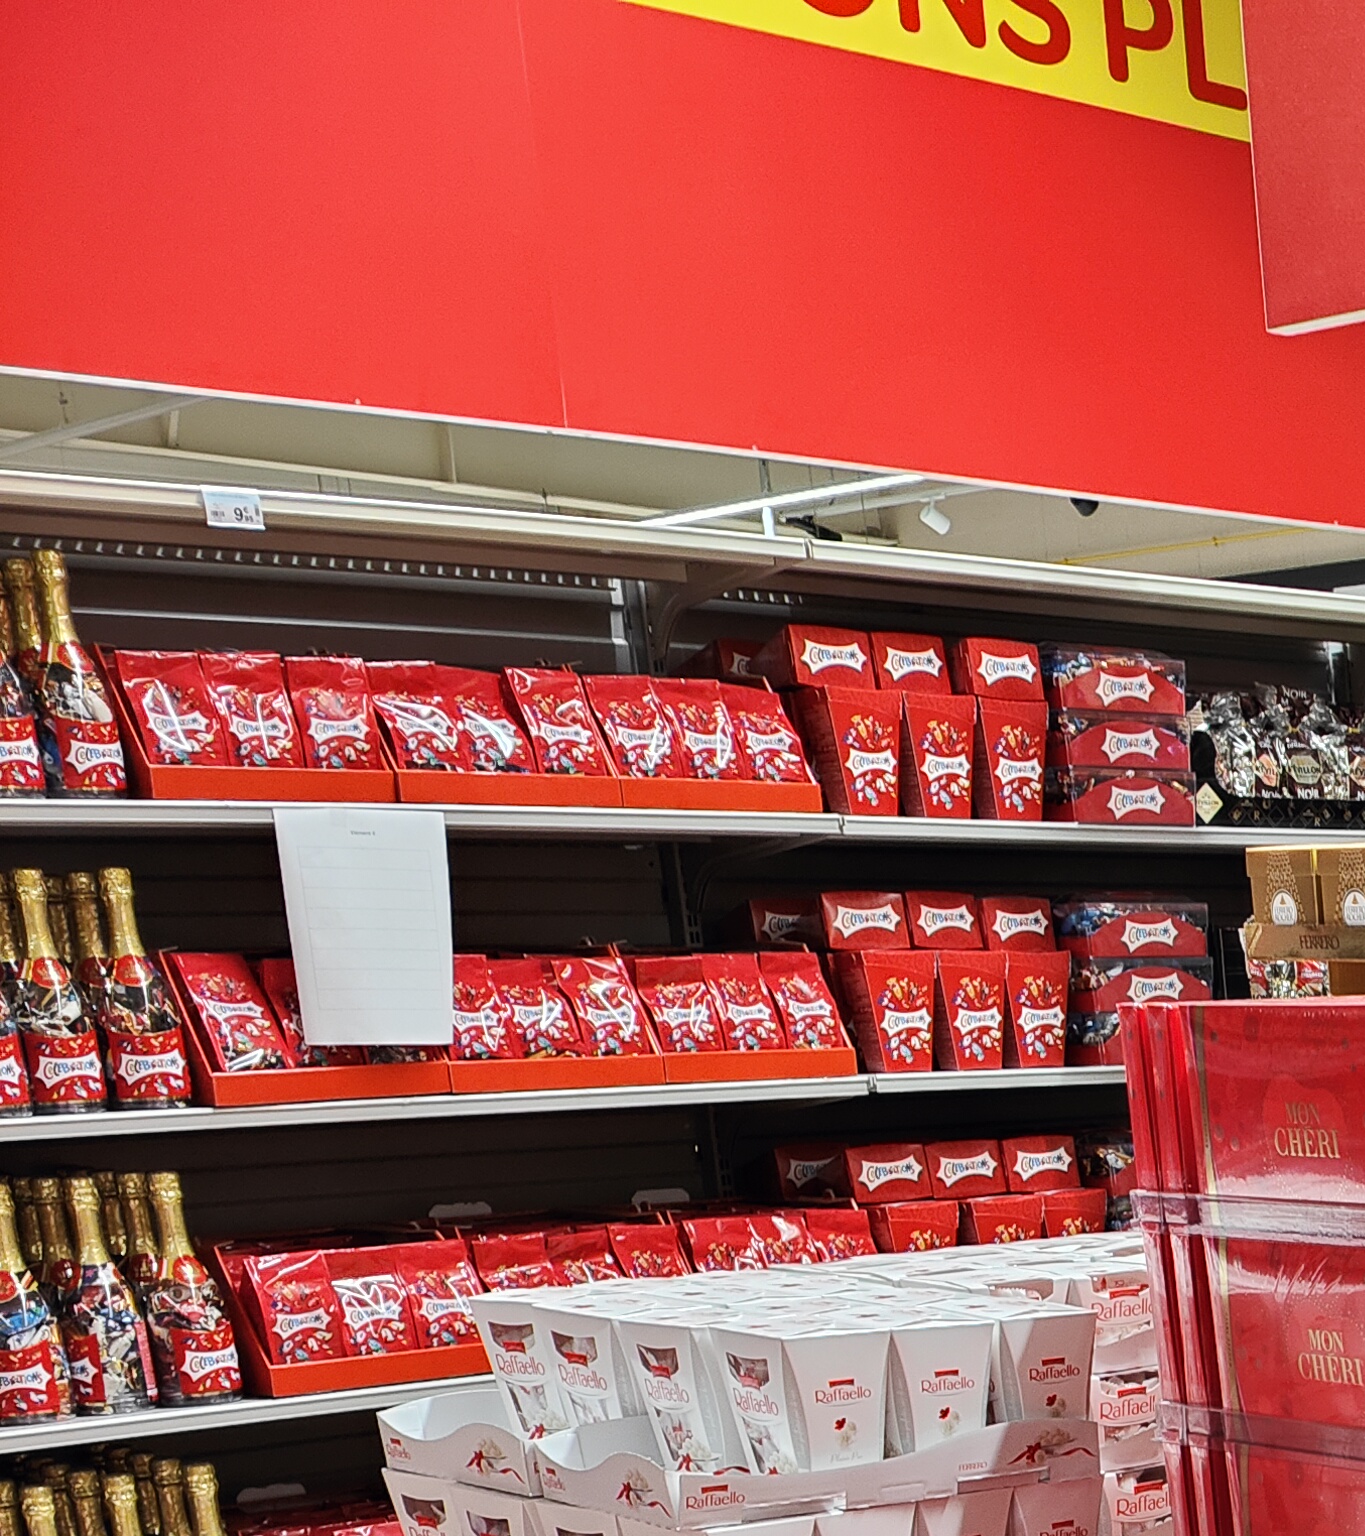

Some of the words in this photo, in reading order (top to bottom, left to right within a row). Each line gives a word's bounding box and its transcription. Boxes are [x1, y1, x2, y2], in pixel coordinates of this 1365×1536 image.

[798, 0, 1070, 65] NS
[808, 646, 860, 666] CELEBRATIONS
[890, 651, 938, 671] CELEBRATIONS
[985, 655, 1032, 675] CELEBRATIONS
[1102, 675, 1150, 698] CELEBRATIONS
[1109, 733, 1156, 755] CELEBRATIONS
[1115, 789, 1161, 811] CELEBRATIONS
[840, 911, 893, 930] CELEBRATIONS
[922, 909, 968, 927] CELEBRATIONS
[999, 914, 1045, 932] CELEBRATIONS
[1127, 924, 1172, 946] CELEBRATIONS
[1299, 934, 1340, 950] FERRERO
[44, 1056, 97, 1079] CELEBRATIONS
[125, 1057, 180, 1076] CELEBRATIONS
[1284, 1102, 1322, 1128] MON
[1274, 1122, 1341, 1160] CHÉRI
[865, 1155, 917, 1184] CELEBRATIONS
[944, 1156, 991, 1181] CELEBRATIONS
[1019, 1150, 1067, 1176] CELEBRATIONS
[1308, 1329, 1345, 1354] MON
[495, 1352, 545, 1376] Raffaello
[1028, 1363, 1081, 1383] Raffaello
[1296, 1351, 1365, 1388] CHÉRI
[558, 1364, 608, 1391] Raffaello
[920, 1374, 975, 1393] Raffaello
[645, 1377, 689, 1405] Raffaello
[732, 1387, 779, 1417] Raffaello
[814, 1384, 872, 1404] Raffaello
[684, 1488, 746, 1510] Raffaello
